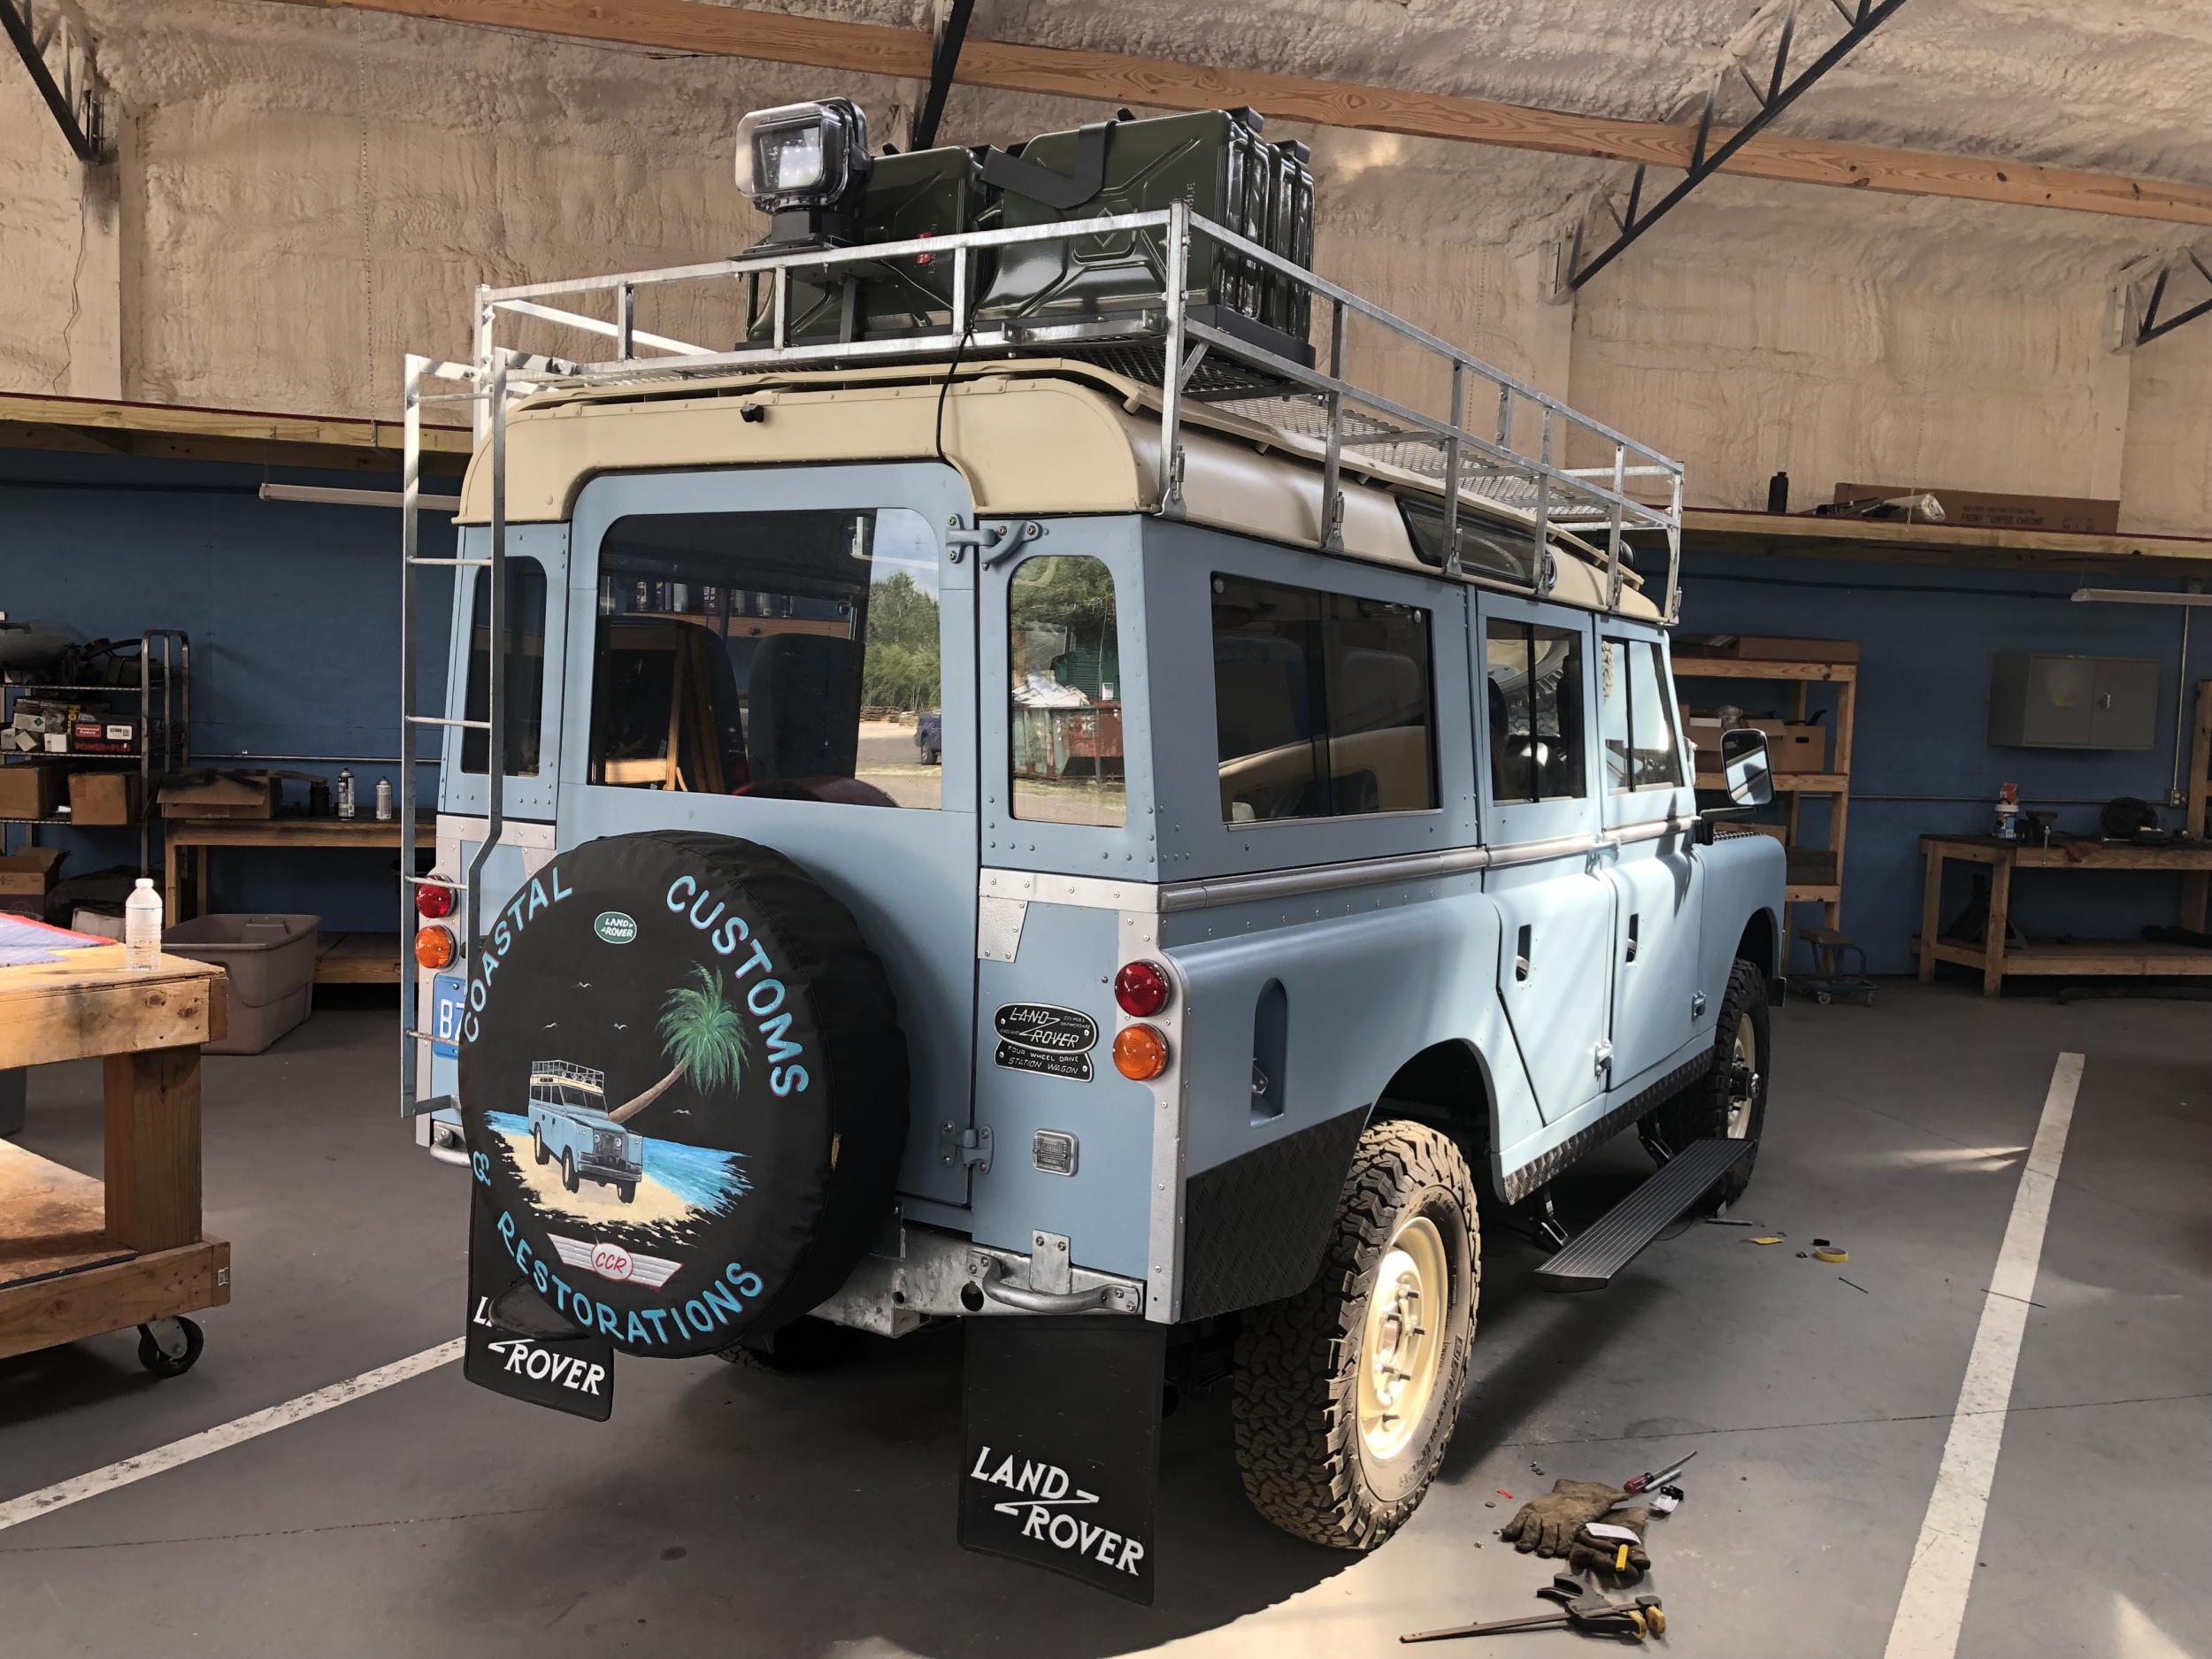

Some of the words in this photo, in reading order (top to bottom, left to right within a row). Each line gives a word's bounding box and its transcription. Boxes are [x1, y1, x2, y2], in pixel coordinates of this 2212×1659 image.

[605, 918, 628, 927] LAND
[605, 926, 633, 937] ROVER
[464, 866, 573, 1043] COASTAL
[666, 875, 810, 1097] CUSTOMS
[1010, 1008, 1049, 1025] LAND
[1030, 1029, 1079, 1048] ROVER
[1007, 1045, 1025, 1055] FOUR
[1030, 1052, 1056, 1062] WHEEL
[1008, 1056, 1042, 1068] STATION
[1048, 1063, 1079, 1074] WAGON
[595, 1252, 627, 1273] CCR
[497, 1210, 764, 1346] RESTORATIONS
[503, 1342, 605, 1395] ROVER
[971, 1446, 1070, 1500] LAND
[1021, 1504, 1145, 1576] ROVER
